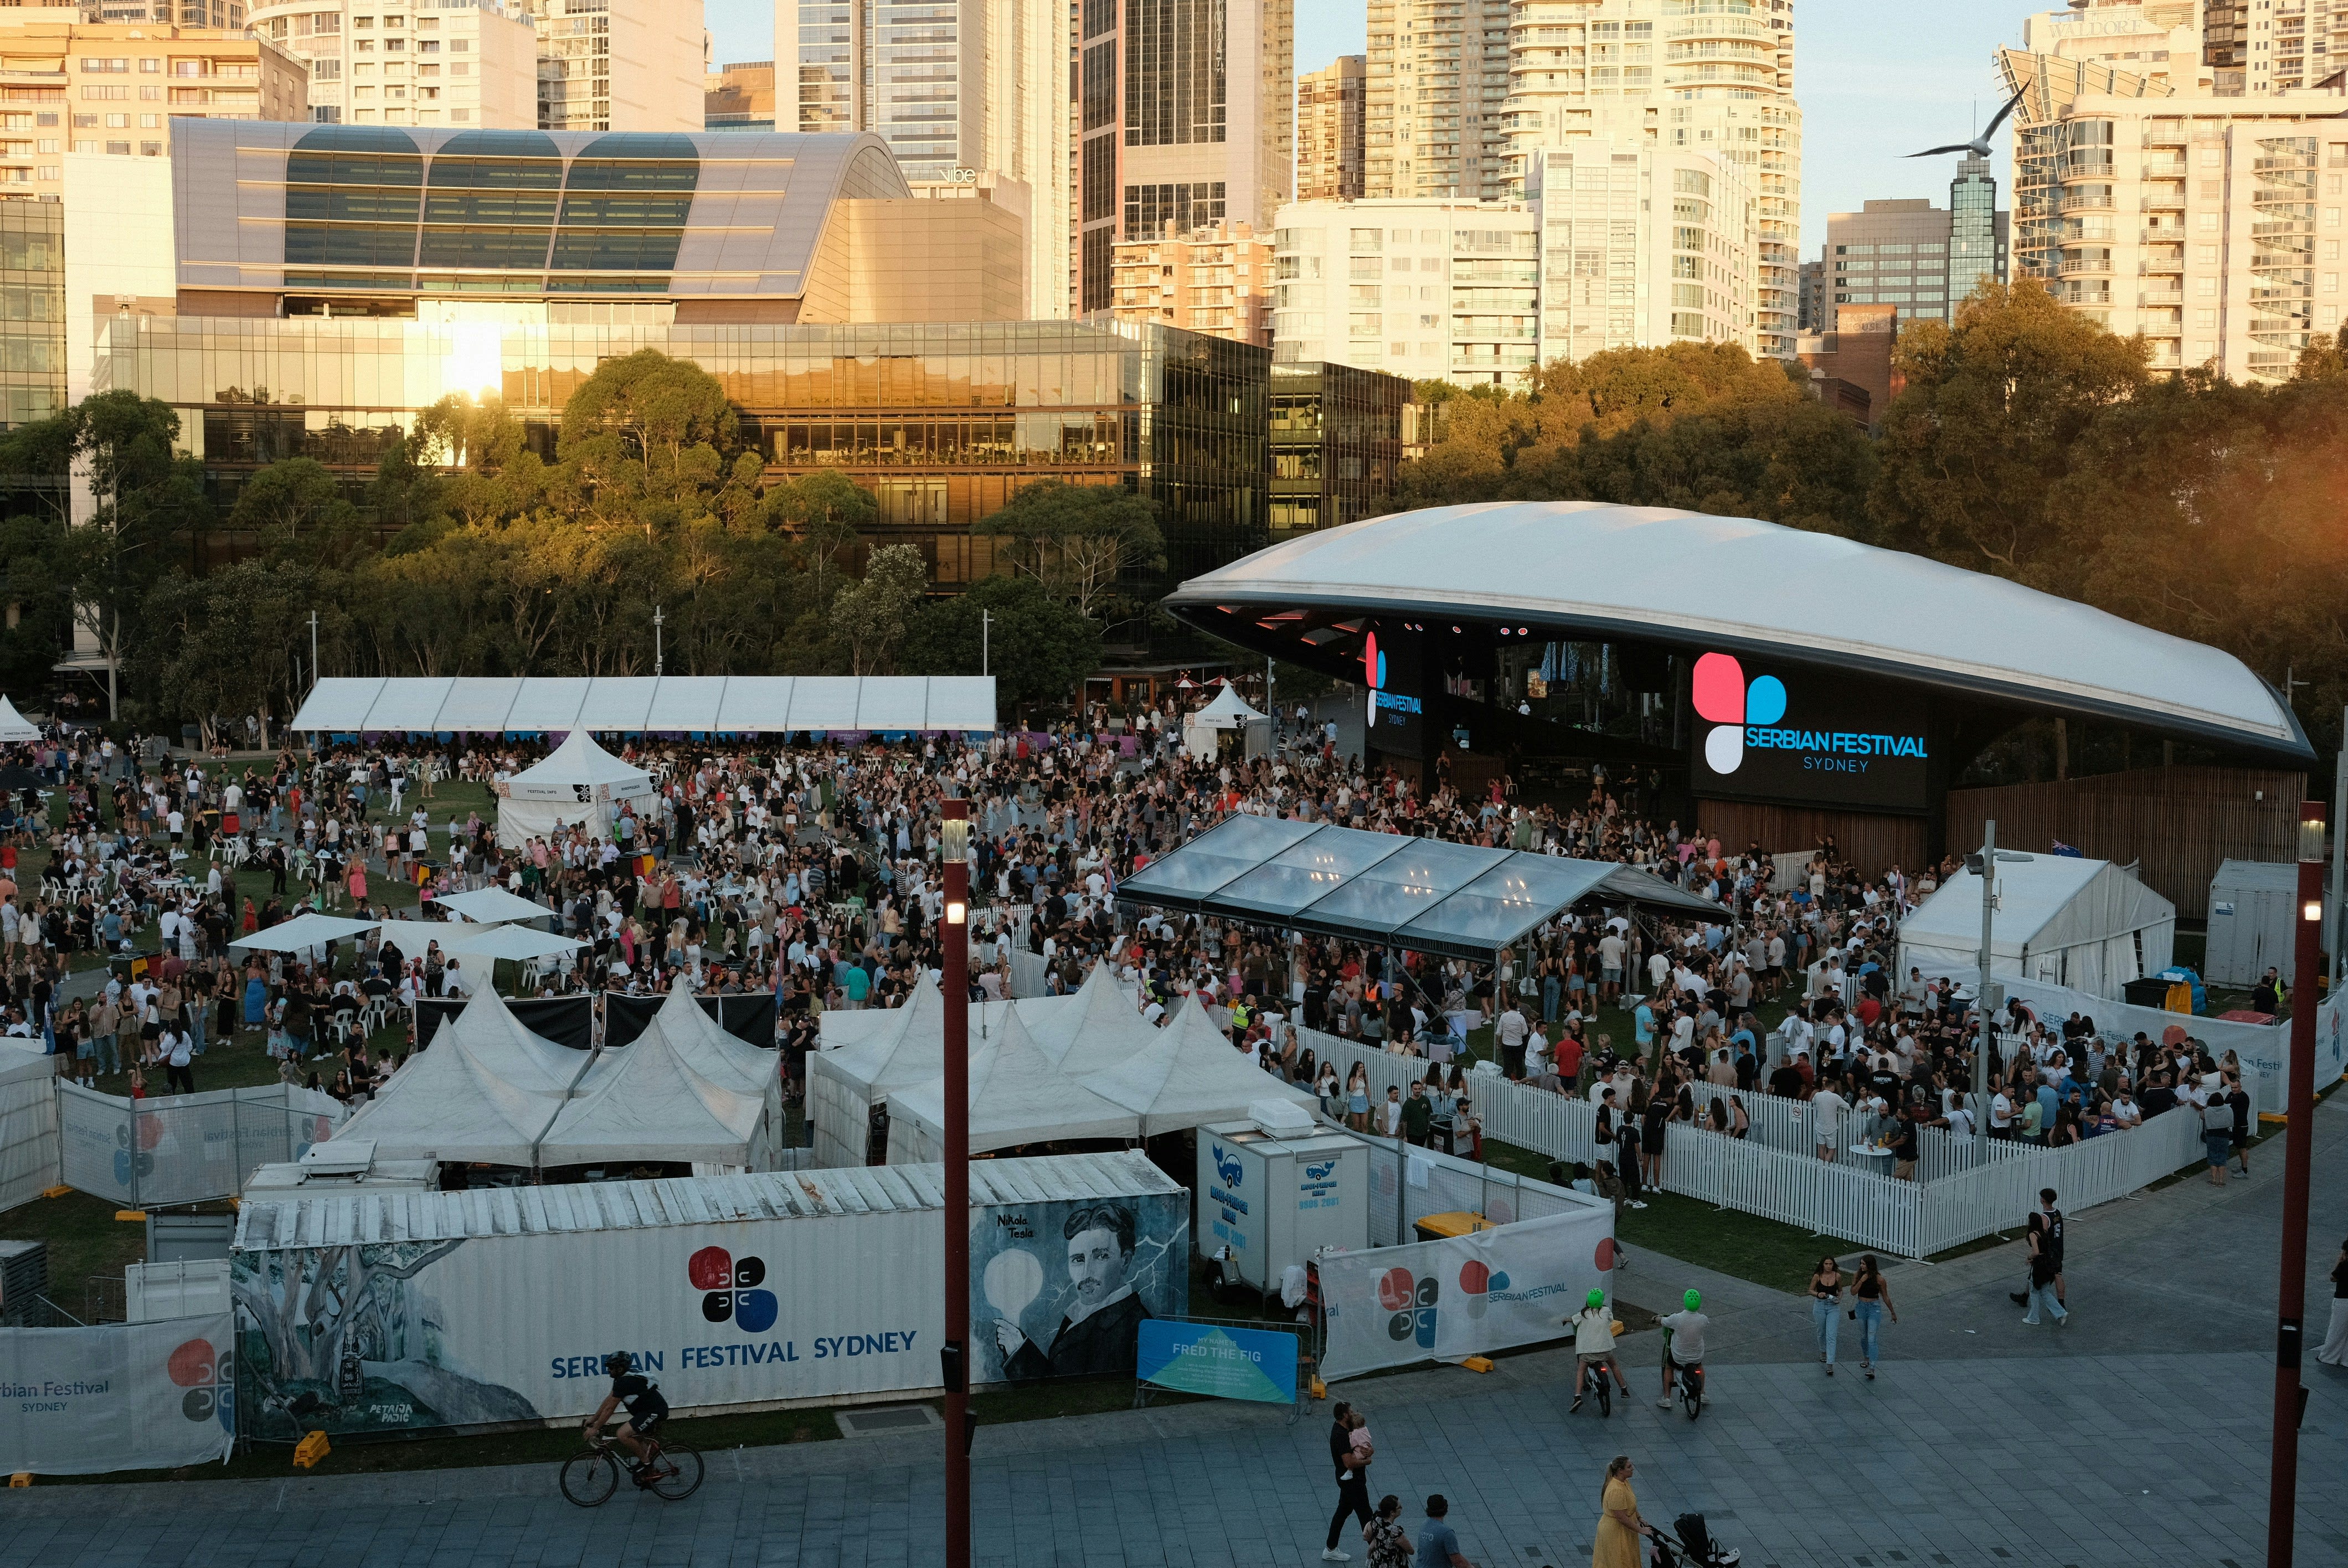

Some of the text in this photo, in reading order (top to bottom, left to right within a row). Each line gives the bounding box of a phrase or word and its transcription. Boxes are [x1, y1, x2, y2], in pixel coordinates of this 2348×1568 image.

[2048, 19, 2143, 38] WALDORF
[939, 163, 976, 183] vibe
[1376, 691, 1422, 714] SERBIAN FESTIVAL
[1388, 714, 1405, 726] SYDNEY
[1745, 727, 1927, 757] SERBIAN FESTIVAL
[1804, 757, 1868, 772] SYDNEY
[2257, 1059, 2281, 1070] Festi
[1301, 1181, 1337, 1190] MOBI-FRIDGE
[1211, 1185, 1248, 1215] MOBI-FRIDGE
[998, 1214, 1028, 1226] Nikola
[1222, 1207, 1236, 1225] HIRE
[1489, 1283, 1568, 1303] SERBIAN FESTIVAL
[552, 1330, 916, 1379] SERAN FESTIVAL SYDNEY
[1173, 1343, 1261, 1362] FRED THE FIG
[0, 1380, 109, 1397] bian Festival
[22, 1401, 68, 1412] SYDNEY
